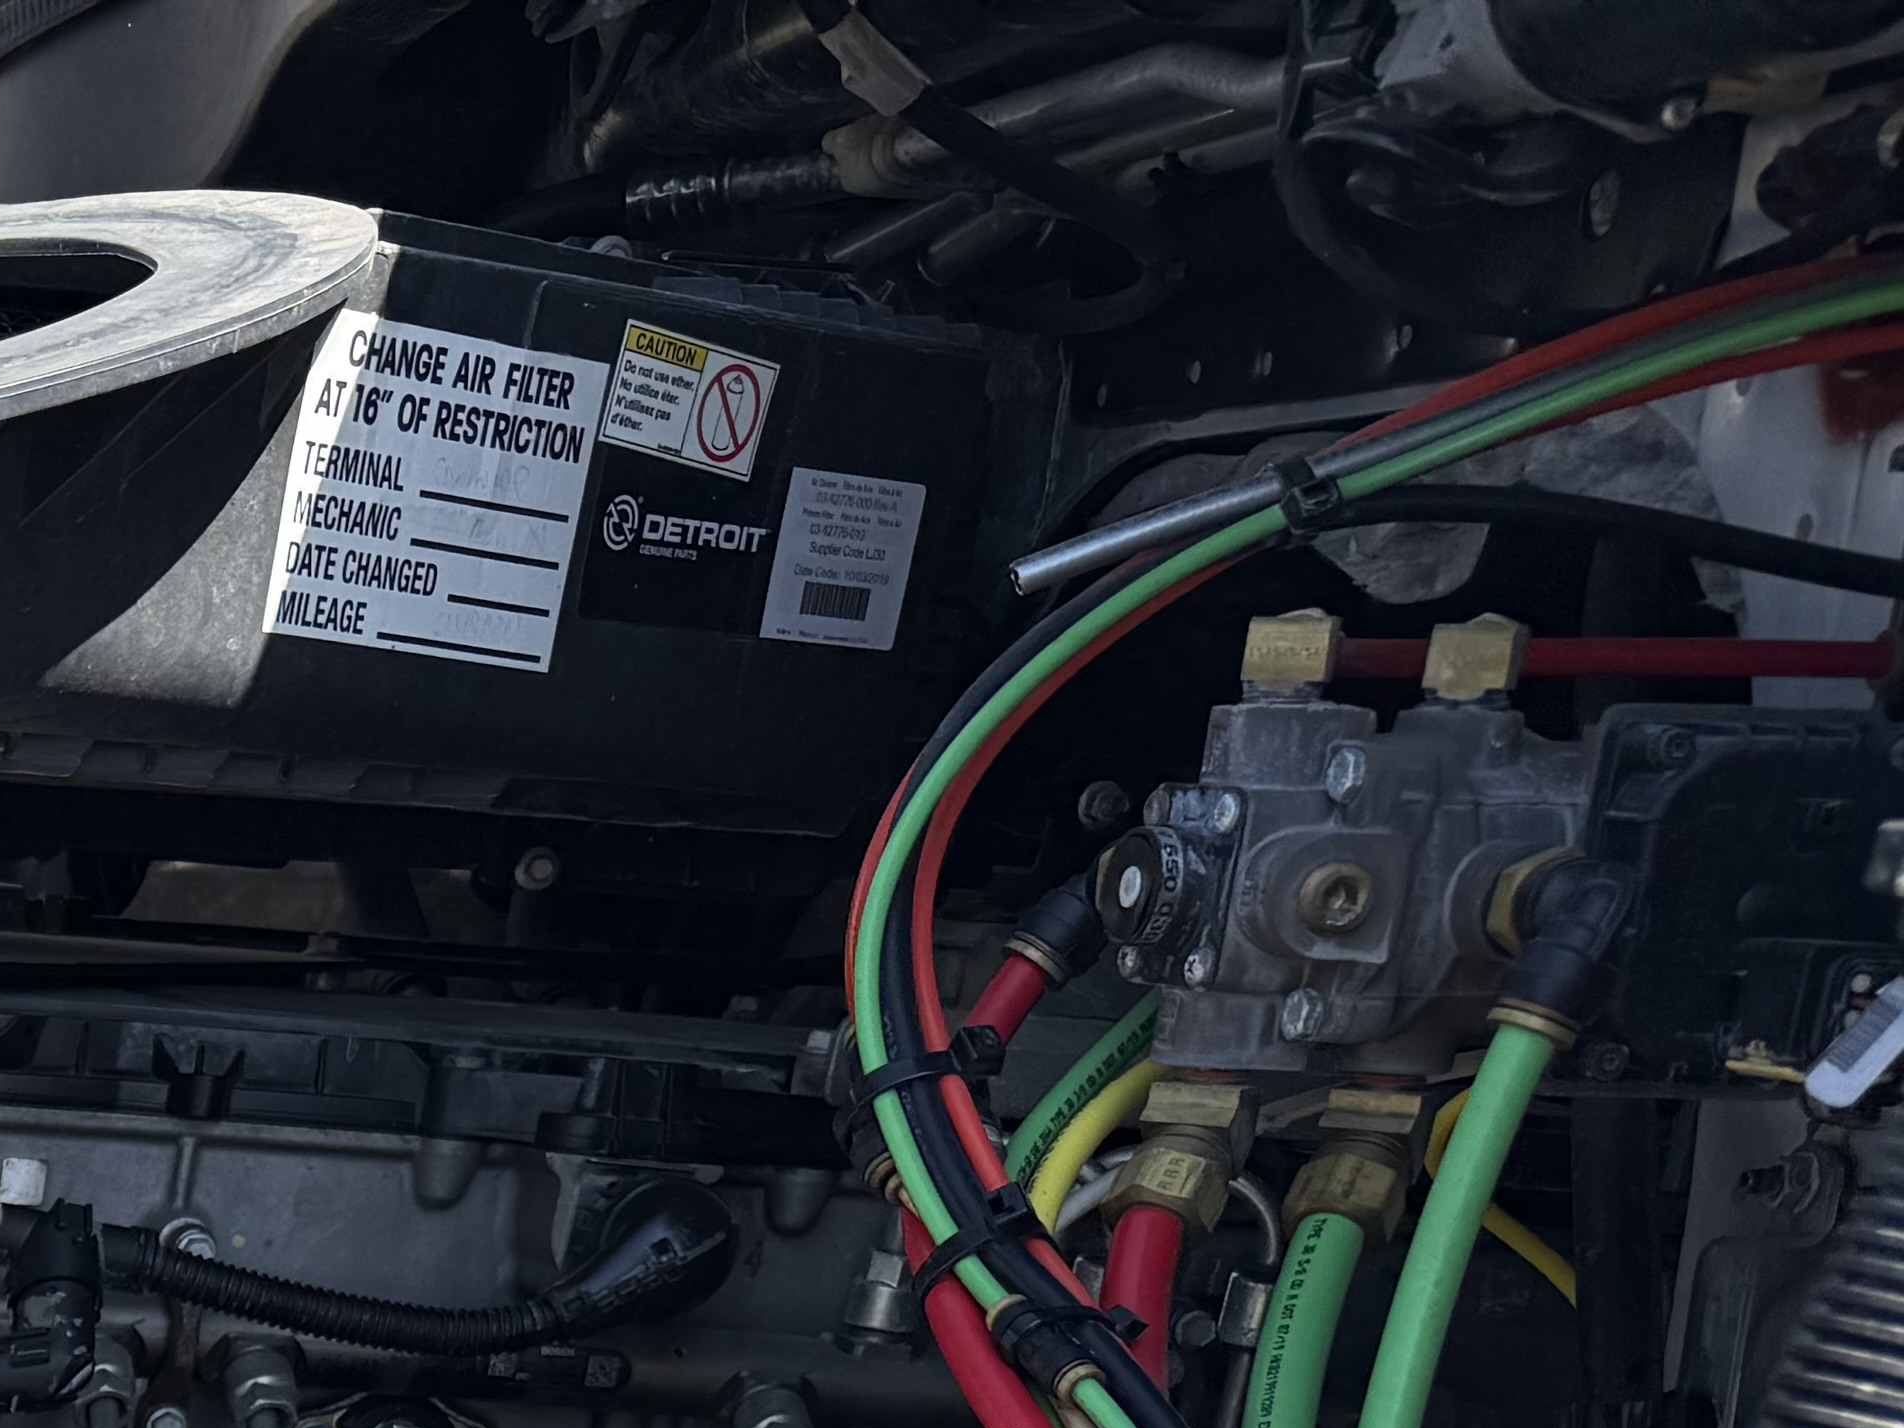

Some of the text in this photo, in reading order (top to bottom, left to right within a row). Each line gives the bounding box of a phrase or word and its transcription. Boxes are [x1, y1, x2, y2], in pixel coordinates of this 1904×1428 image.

[349, 330, 574, 410] CHANGE AIR FILTER
[635, 333, 697, 365] CAUTION
[314, 378, 347, 417] AT
[397, 393, 431, 434] OF
[433, 400, 585, 463] RESTRICTION
[304, 440, 404, 491] TERMINAL
[294, 491, 401, 541] MECHANIC
[642, 513, 767, 553] DETROIT
[285, 541, 438, 597] DATE CHANGED
[276, 590, 367, 635] MILEAGE
